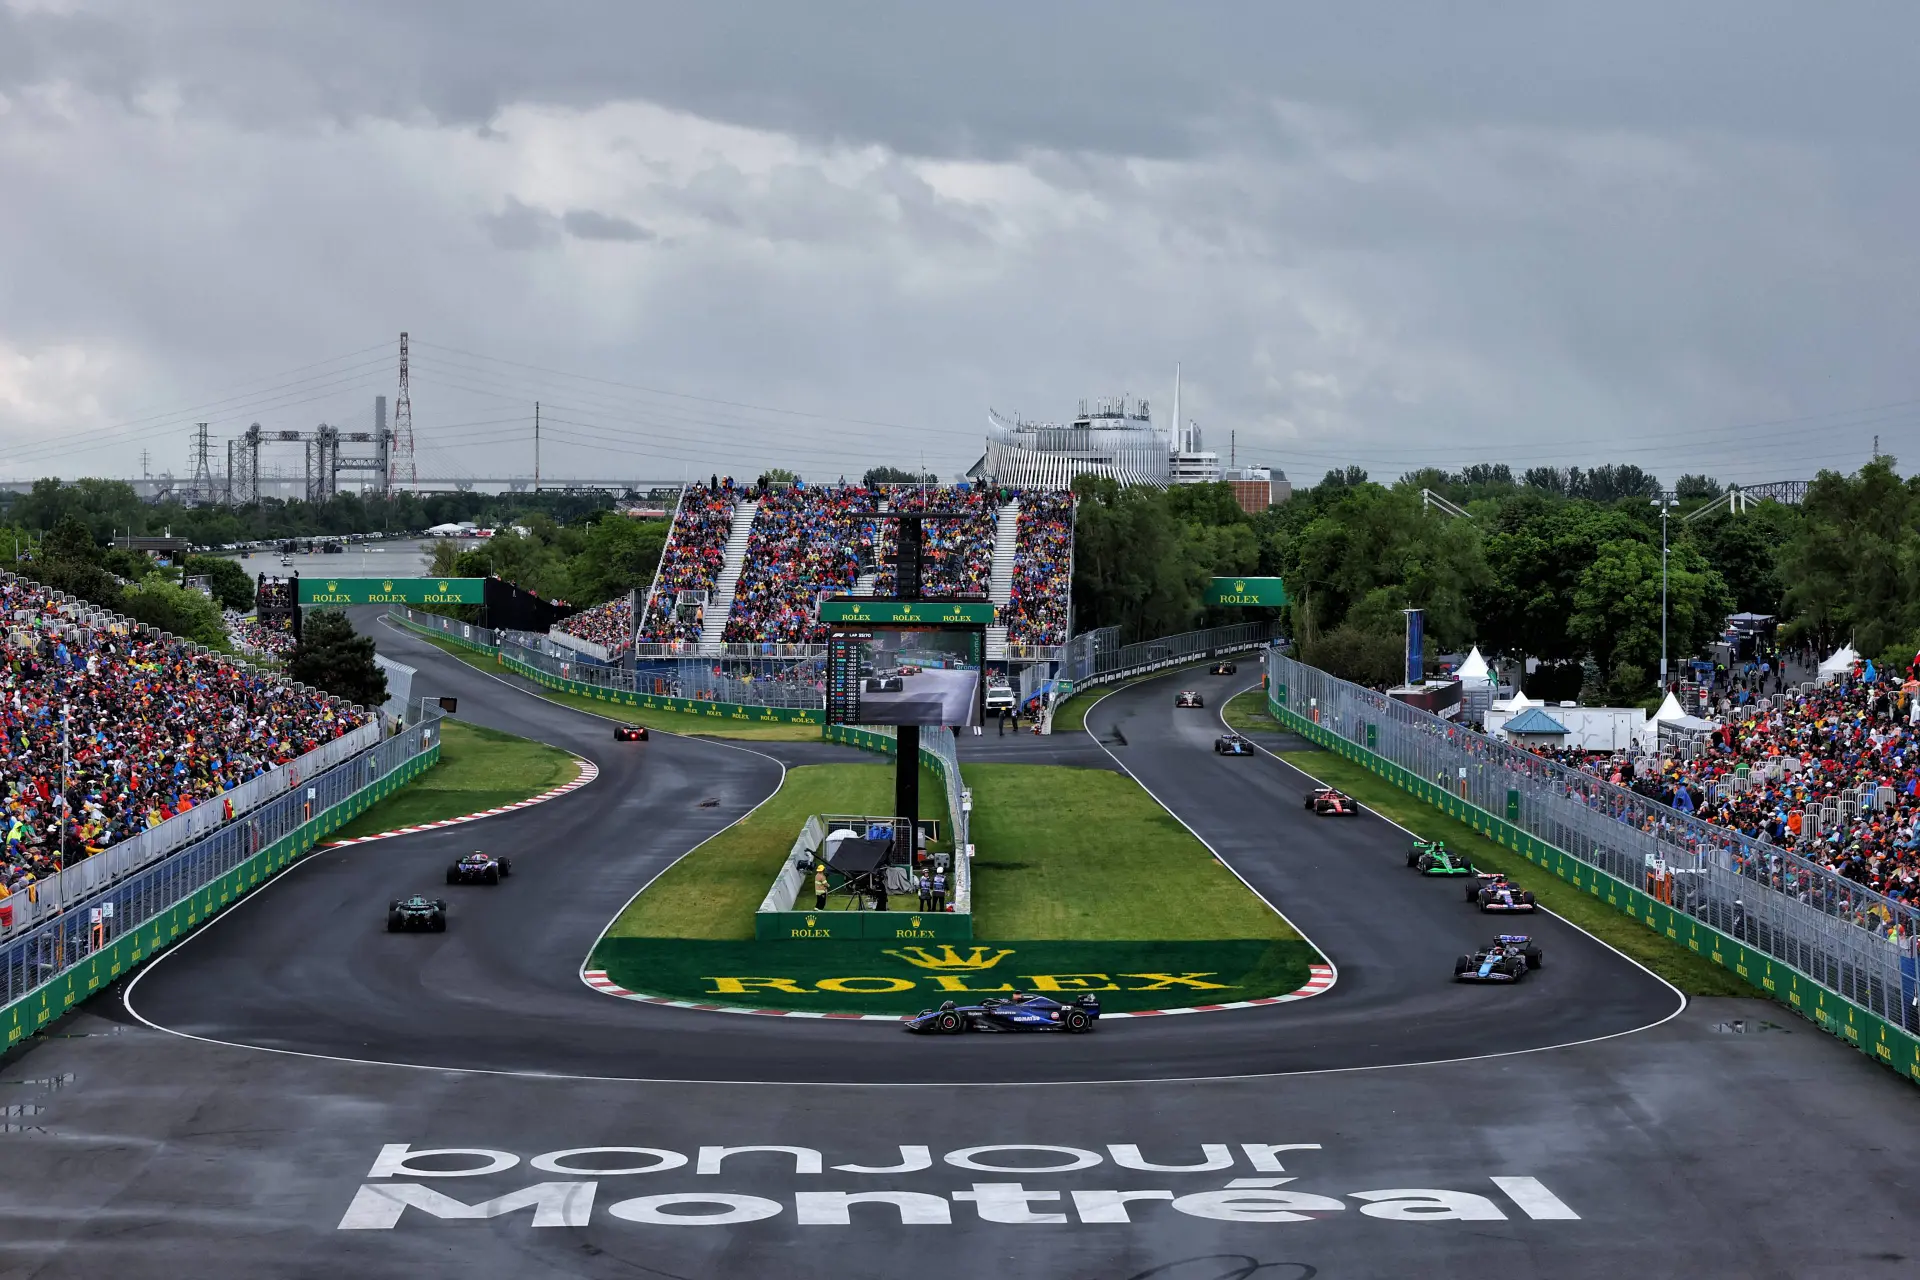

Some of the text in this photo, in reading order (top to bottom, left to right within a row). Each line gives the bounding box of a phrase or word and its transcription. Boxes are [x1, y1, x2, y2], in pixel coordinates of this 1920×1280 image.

[1220, 595, 1259, 604] ROLEX
[732, 712, 749, 720] ROLEX
[791, 929, 831, 937] ROLEX
[896, 930, 935, 938] ROLEX
[700, 972, 1239, 993] ROLEX
[1763, 977, 1775, 991] ROLEX
[38, 1008, 49, 1024] ROLEX
[8, 1025, 21, 1042] ROLEX
[1876, 1042, 1891, 1060] ROLEX
[367, 1144, 1322, 1178] bonjour
[337, 1177, 1582, 1230] Montréal
